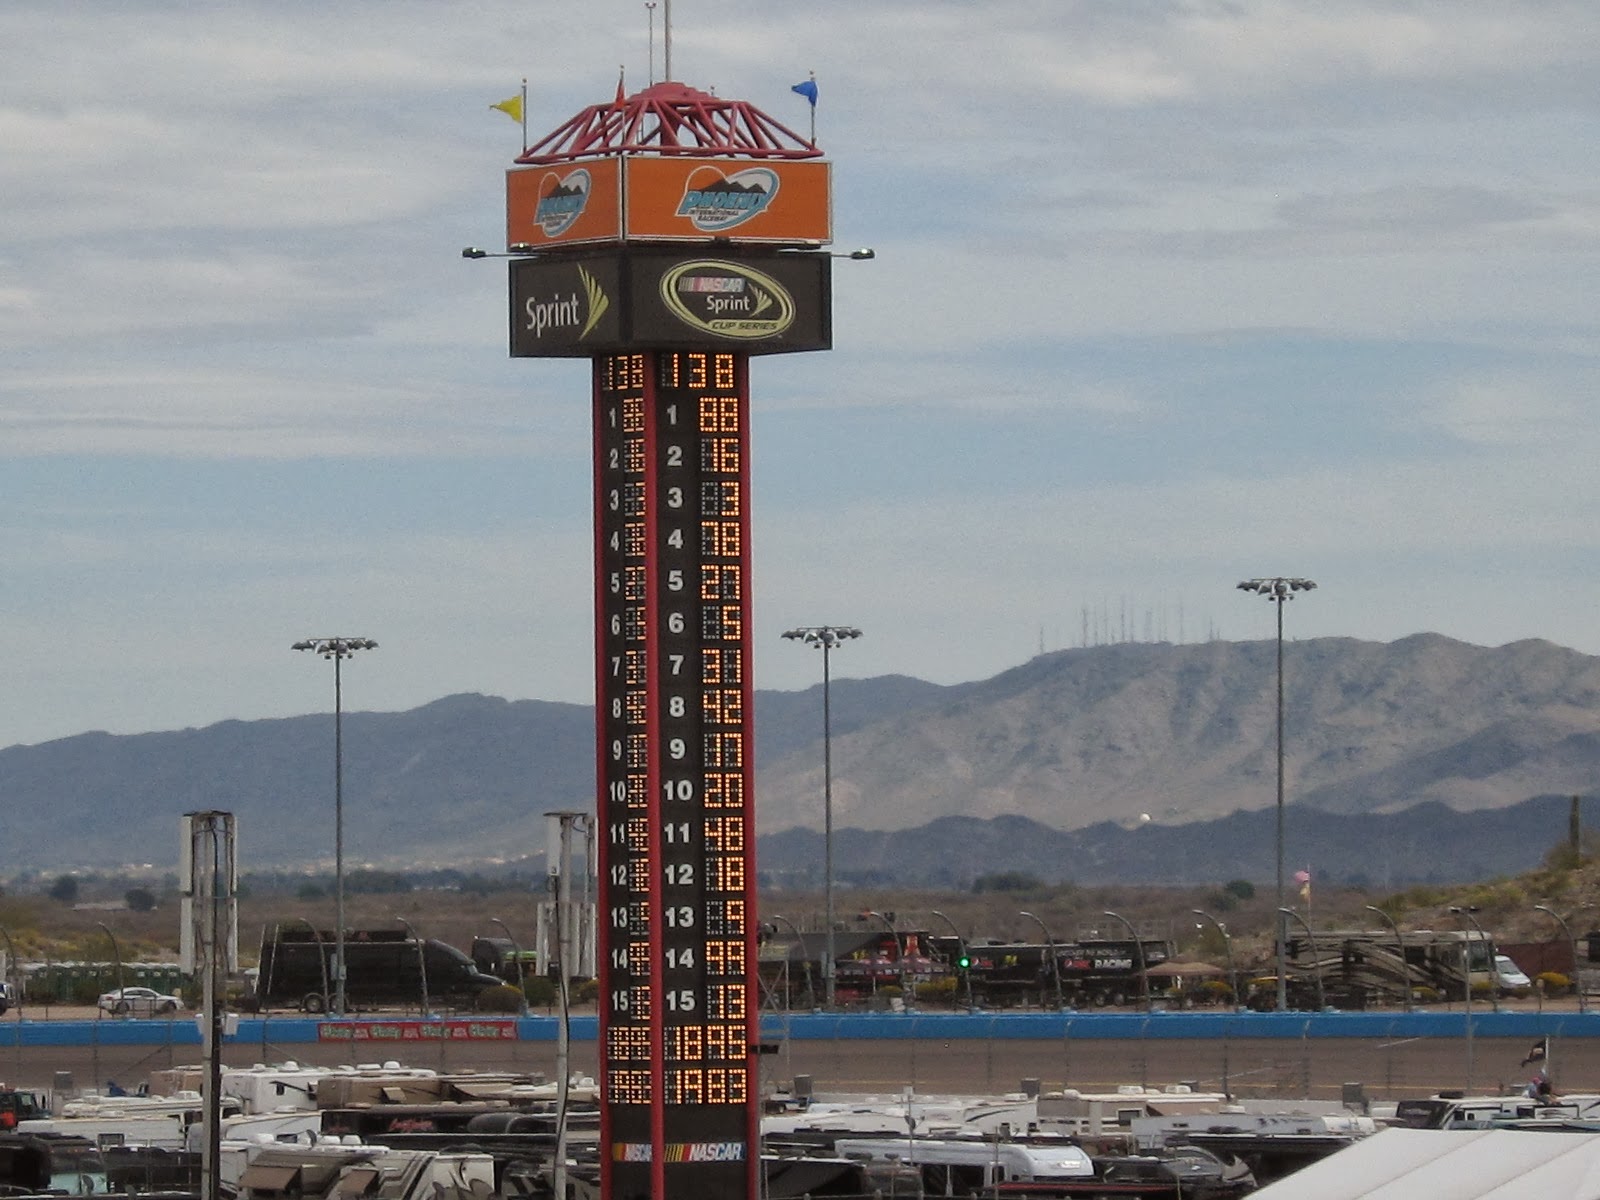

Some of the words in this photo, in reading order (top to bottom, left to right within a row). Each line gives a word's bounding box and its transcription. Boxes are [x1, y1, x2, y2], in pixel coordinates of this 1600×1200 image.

[706, 295, 750, 314] Sprint
[526, 295, 580, 338] Sprint
[712, 321, 736, 330] CUP
[737, 321, 778, 331] SERIES
[673, 353, 734, 389] 138
[609, 408, 616, 427] 1
[667, 404, 676, 425] 1
[699, 397, 736, 432] 88
[610, 448, 619, 469] 2
[667, 445, 682, 466] 2
[713, 438, 737, 473] 16
[610, 489, 619, 511] 3
[667, 487, 683, 508] 3
[721, 482, 738, 516] 3
[610, 531, 620, 551] 4
[667, 528, 684, 549] 4
[701, 521, 739, 557] 78
[611, 572, 620, 593] 5
[668, 570, 684, 591] 5
[701, 565, 739, 600] 27
[611, 614, 620, 635] 6
[668, 612, 685, 634] 6
[722, 605, 740, 640] 5
[612, 656, 621, 677] 7
[669, 654, 684, 675] 7
[702, 649, 741, 684] 31
[612, 697, 622, 719] 8
[669, 696, 685, 718] 8
[703, 689, 742, 724] 42
[612, 739, 622, 761] 9
[669, 738, 686, 760] 9
[713, 733, 742, 767] 17
[610, 780, 625, 802] 10
[663, 779, 693, 801] 10
[704, 773, 743, 808] 20
[610, 823, 625, 844] 11
[664, 822, 690, 843] 11
[704, 817, 744, 852] 48
[611, 864, 626, 885] 12
[664, 863, 694, 885] 12
[715, 856, 744, 891] 18
[611, 907, 627, 928] 13
[665, 906, 694, 928] 13
[726, 900, 745, 935] 9
[612, 948, 627, 969] 14
[665, 948, 695, 969] 14
[706, 941, 745, 975] 99
[1094, 958, 1133, 970] RACING
[612, 990, 628, 1011] 15
[666, 990, 696, 1011] 15
[719, 984, 746, 1019] 13
[688, 1143, 742, 1162] NASCAR
